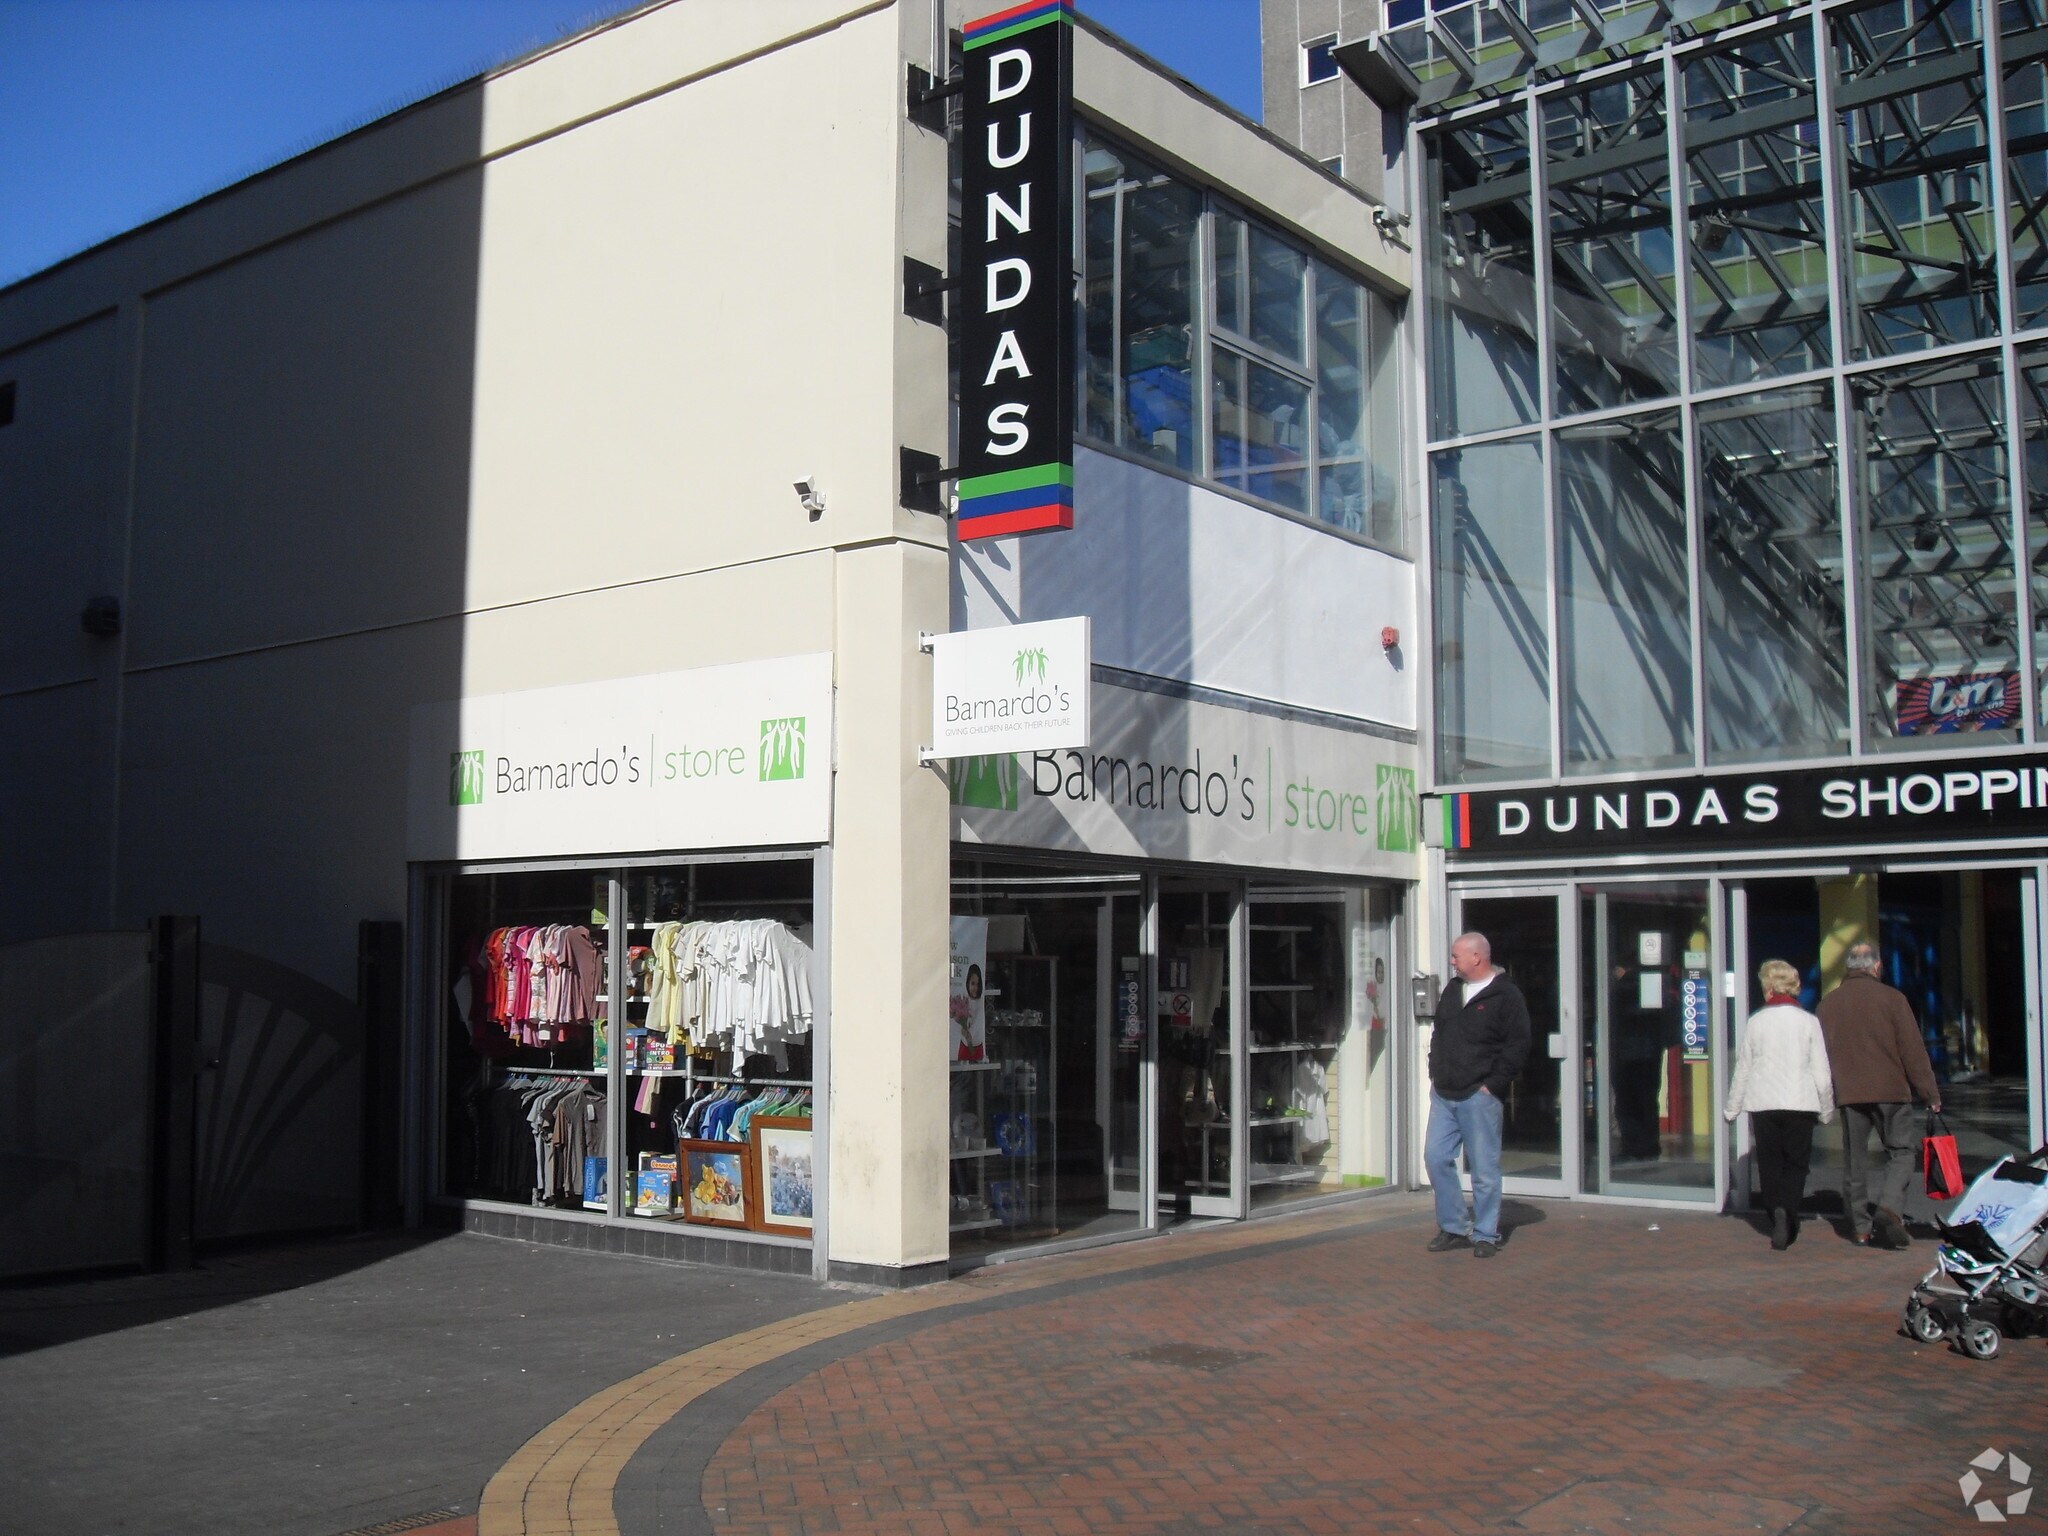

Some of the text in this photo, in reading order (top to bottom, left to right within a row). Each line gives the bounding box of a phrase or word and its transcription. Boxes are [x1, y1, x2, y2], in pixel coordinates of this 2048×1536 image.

[983, 47, 1033, 457] DUNDAS
[945, 717, 1071, 737] GIVING CHILDREN BACK THEIR FUTURE
[946, 684, 1070, 722] Barnardo's
[496, 744, 745, 793] Barnardo's store
[1033, 749, 1367, 835] Barnardo's store
[1499, 785, 1779, 835] DUNDAS
